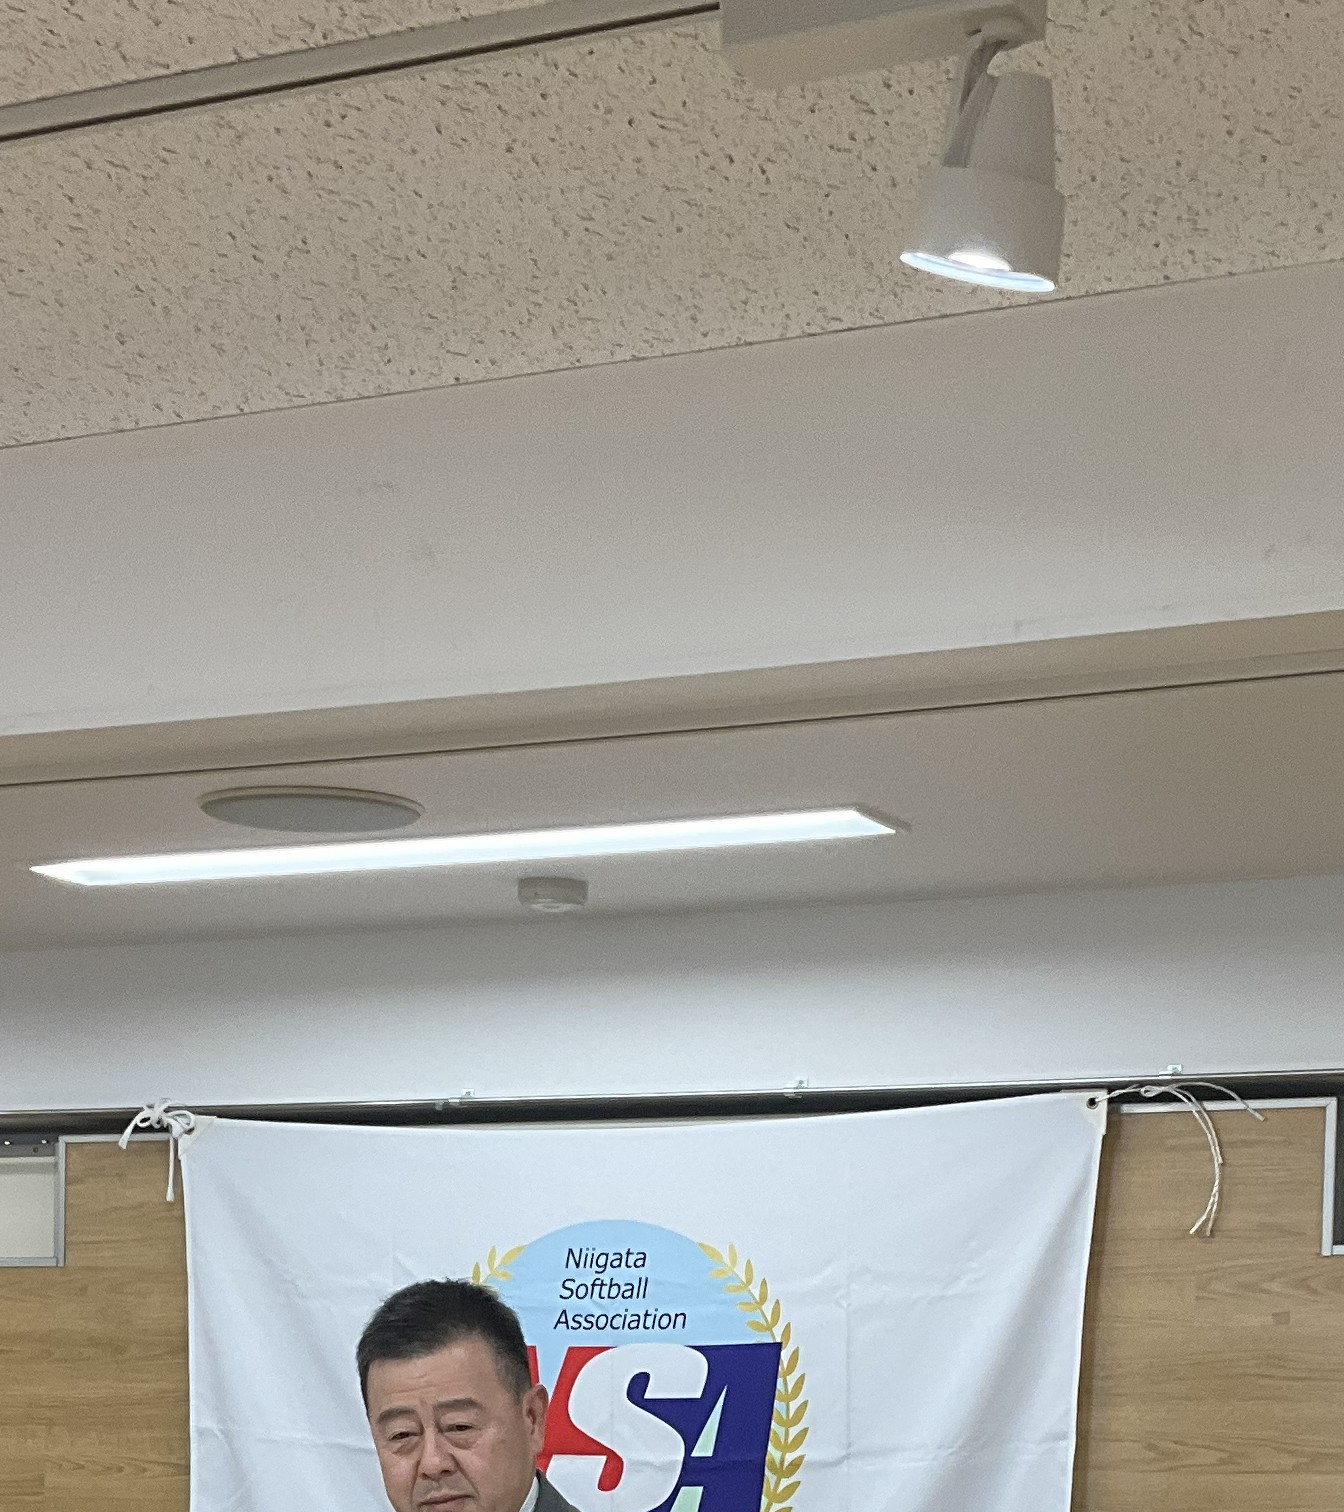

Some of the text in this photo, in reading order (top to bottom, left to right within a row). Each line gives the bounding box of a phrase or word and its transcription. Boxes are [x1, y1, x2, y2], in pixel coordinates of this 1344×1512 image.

[564, 1247, 648, 1273] Niigata
[558, 1277, 648, 1301] Softball
[552, 1308, 688, 1331] Association
